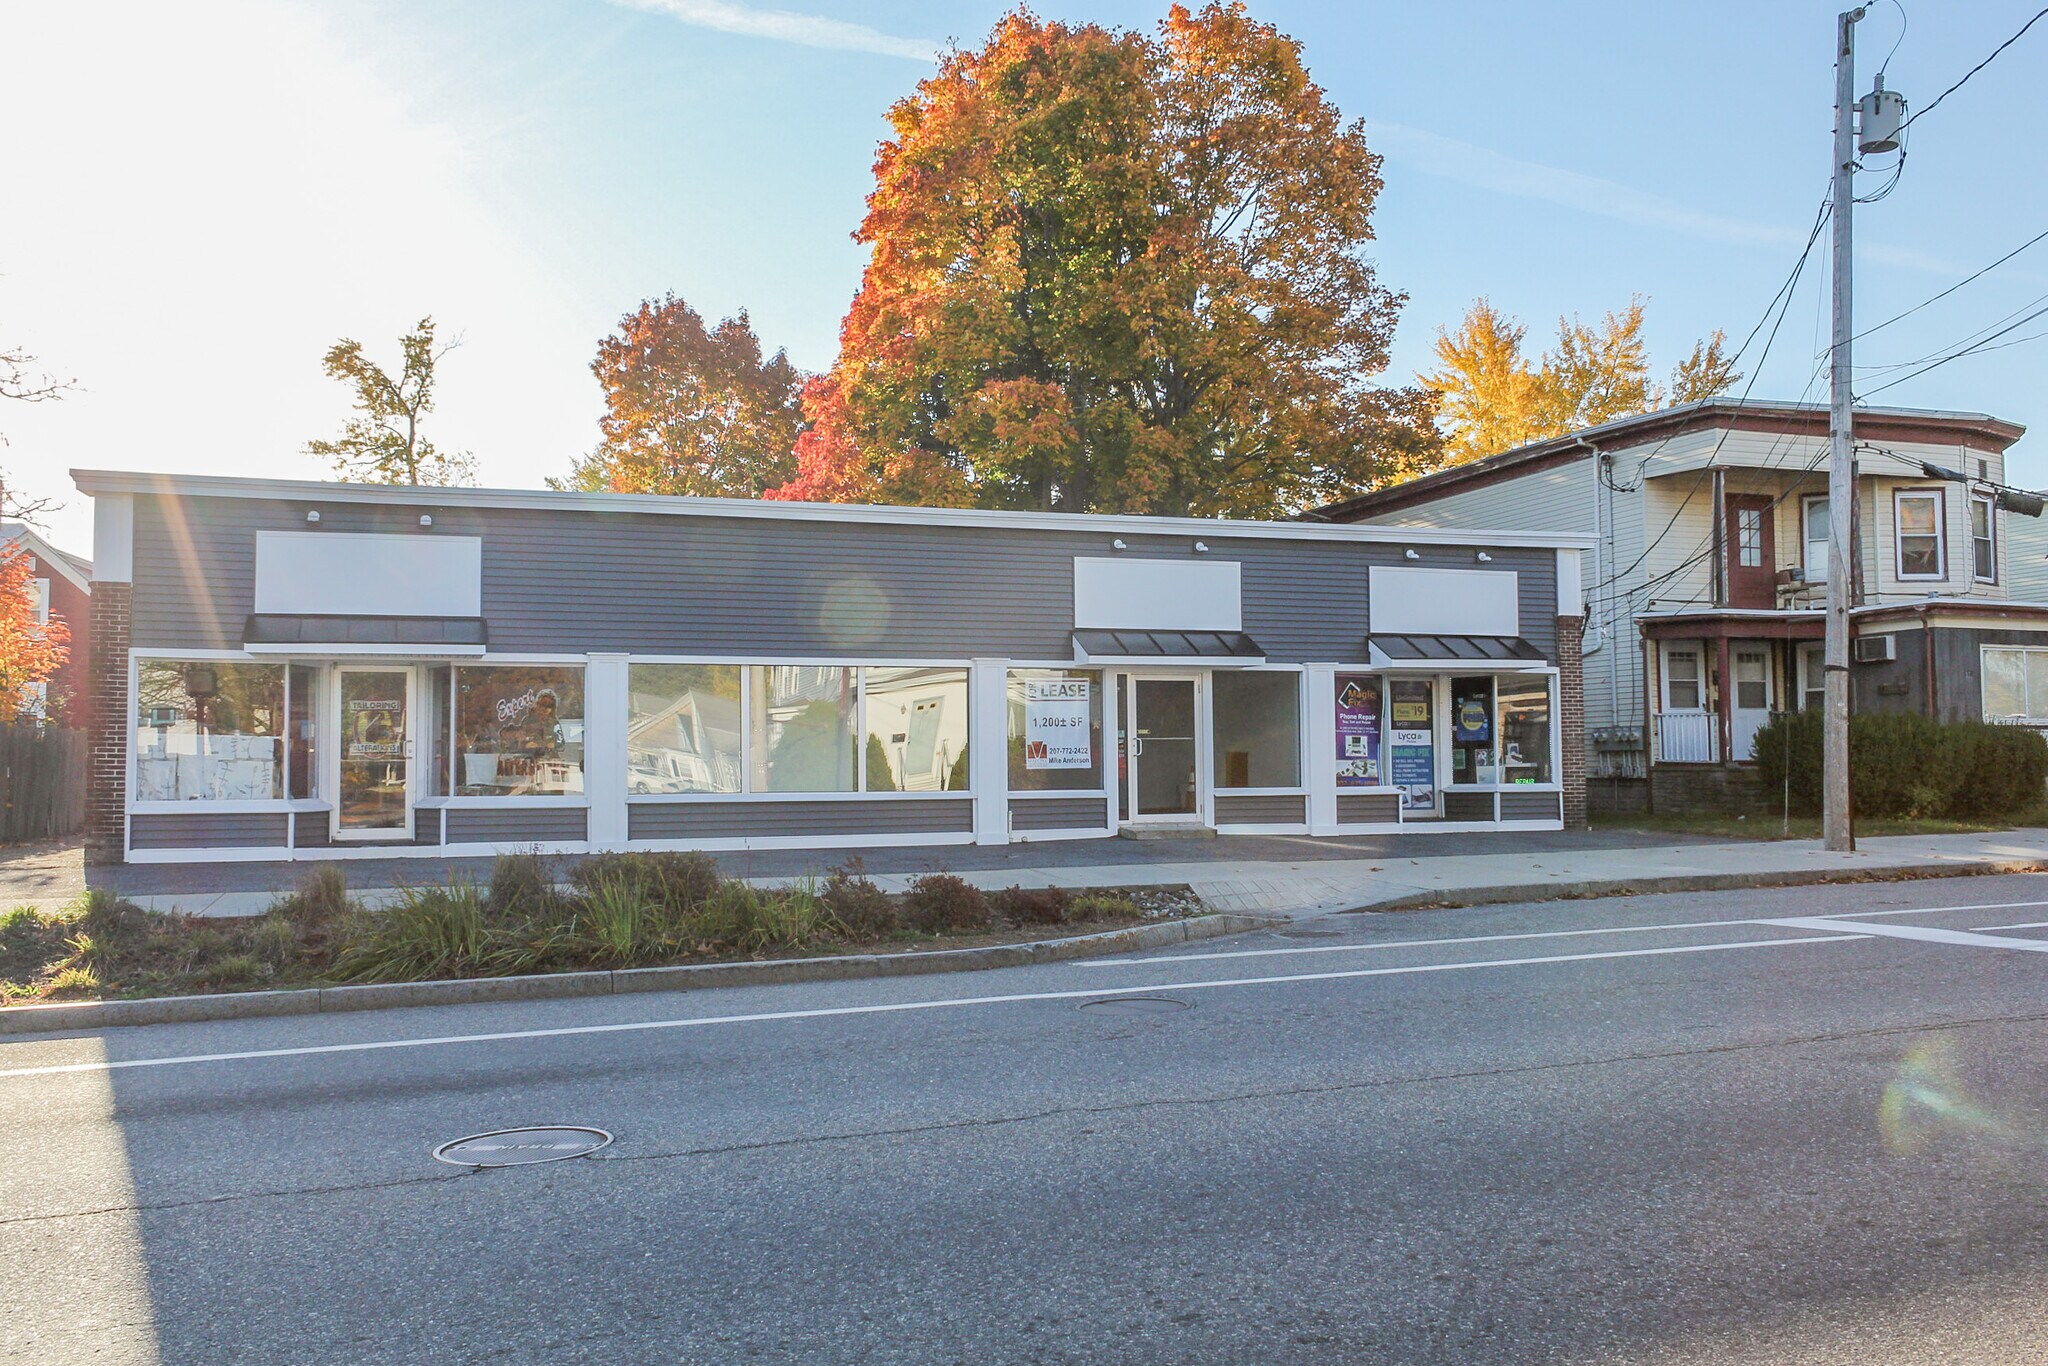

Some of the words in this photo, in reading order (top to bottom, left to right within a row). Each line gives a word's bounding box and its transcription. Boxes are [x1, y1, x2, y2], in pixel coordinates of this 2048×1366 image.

[1028, 683, 1037, 699] FOR
[1041, 684, 1086, 697] LEASE
[1348, 690, 1377, 700] Magic
[497, 689, 535, 721] Expert
[1348, 698, 1361, 706] Fix
[1033, 718, 1067, 728] 1,200±
[1070, 718, 1083, 727] SF
[1398, 732, 1417, 741] Lyca
